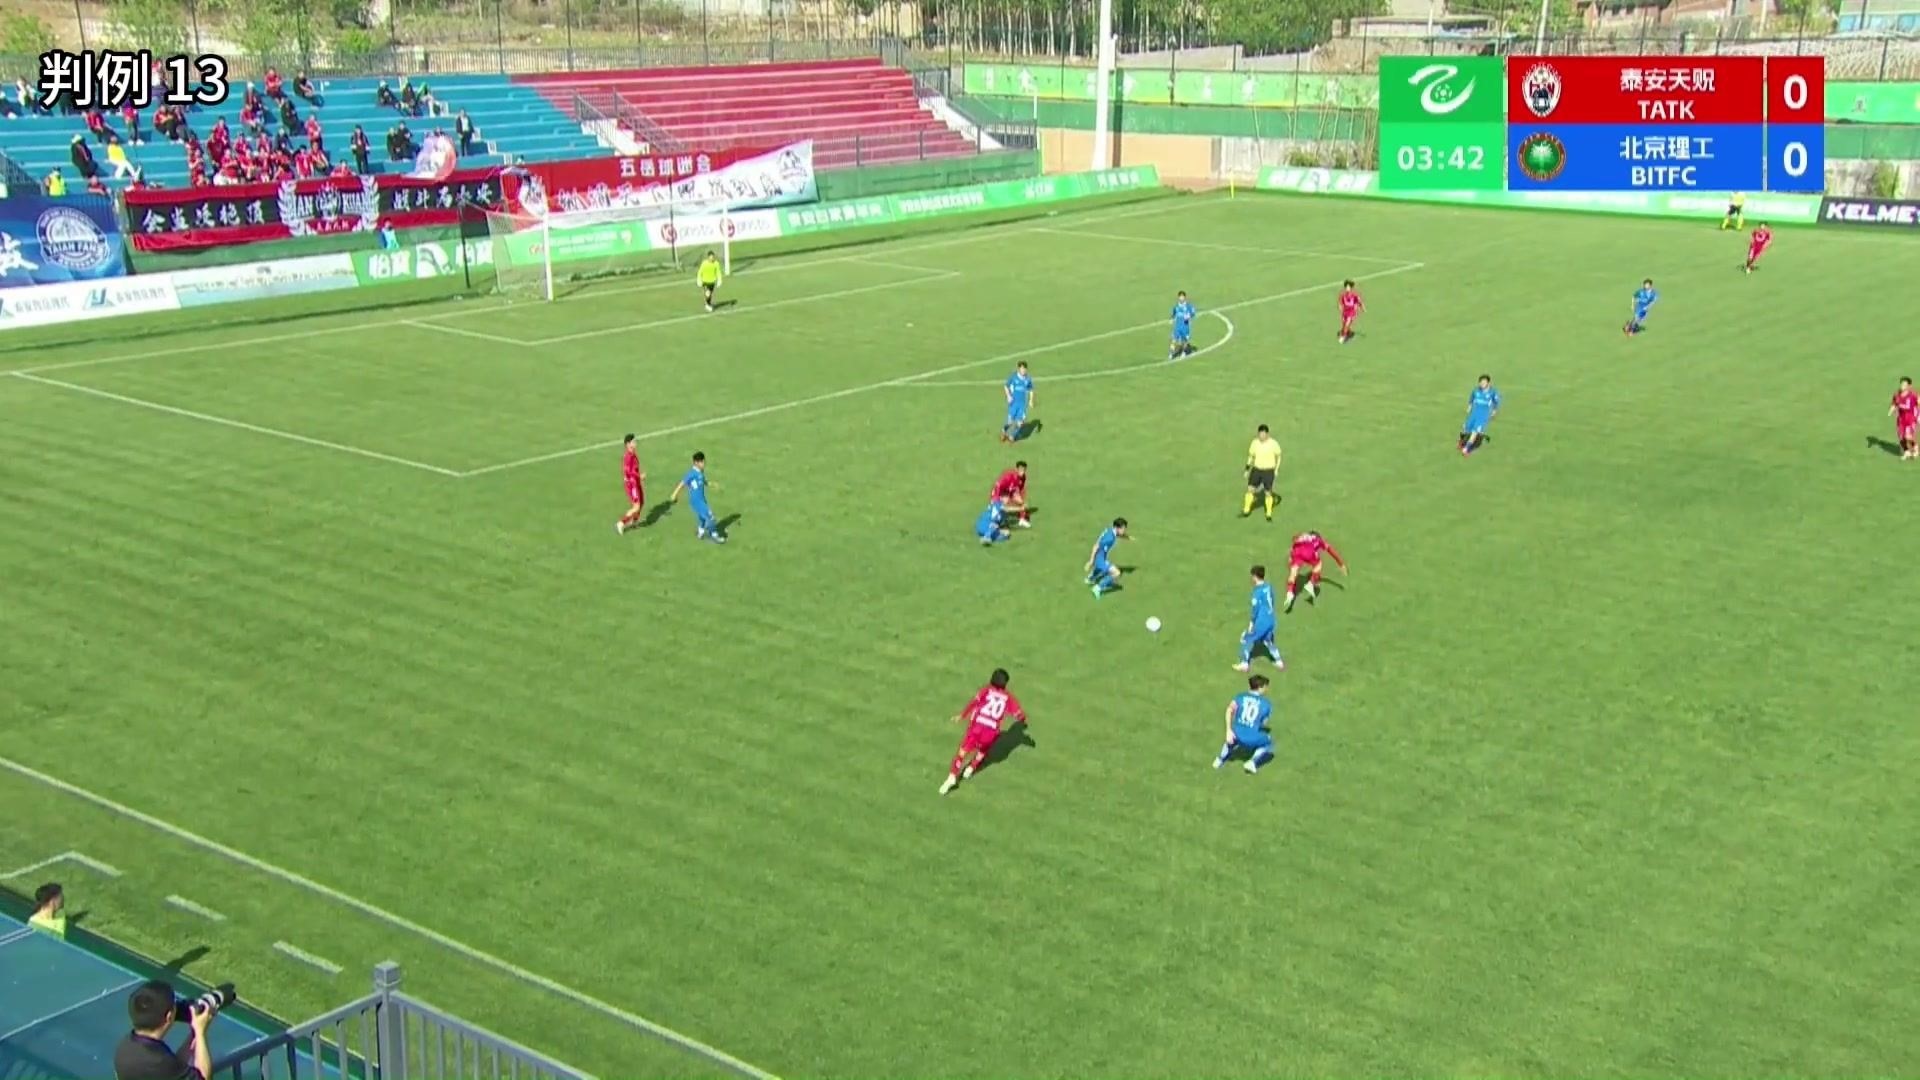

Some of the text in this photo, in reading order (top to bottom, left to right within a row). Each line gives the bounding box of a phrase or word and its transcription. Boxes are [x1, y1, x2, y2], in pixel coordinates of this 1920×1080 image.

[1826, 202, 1916, 223] KELME
[980, 693, 1008, 720] 20
[1241, 699, 1259, 721] 10
